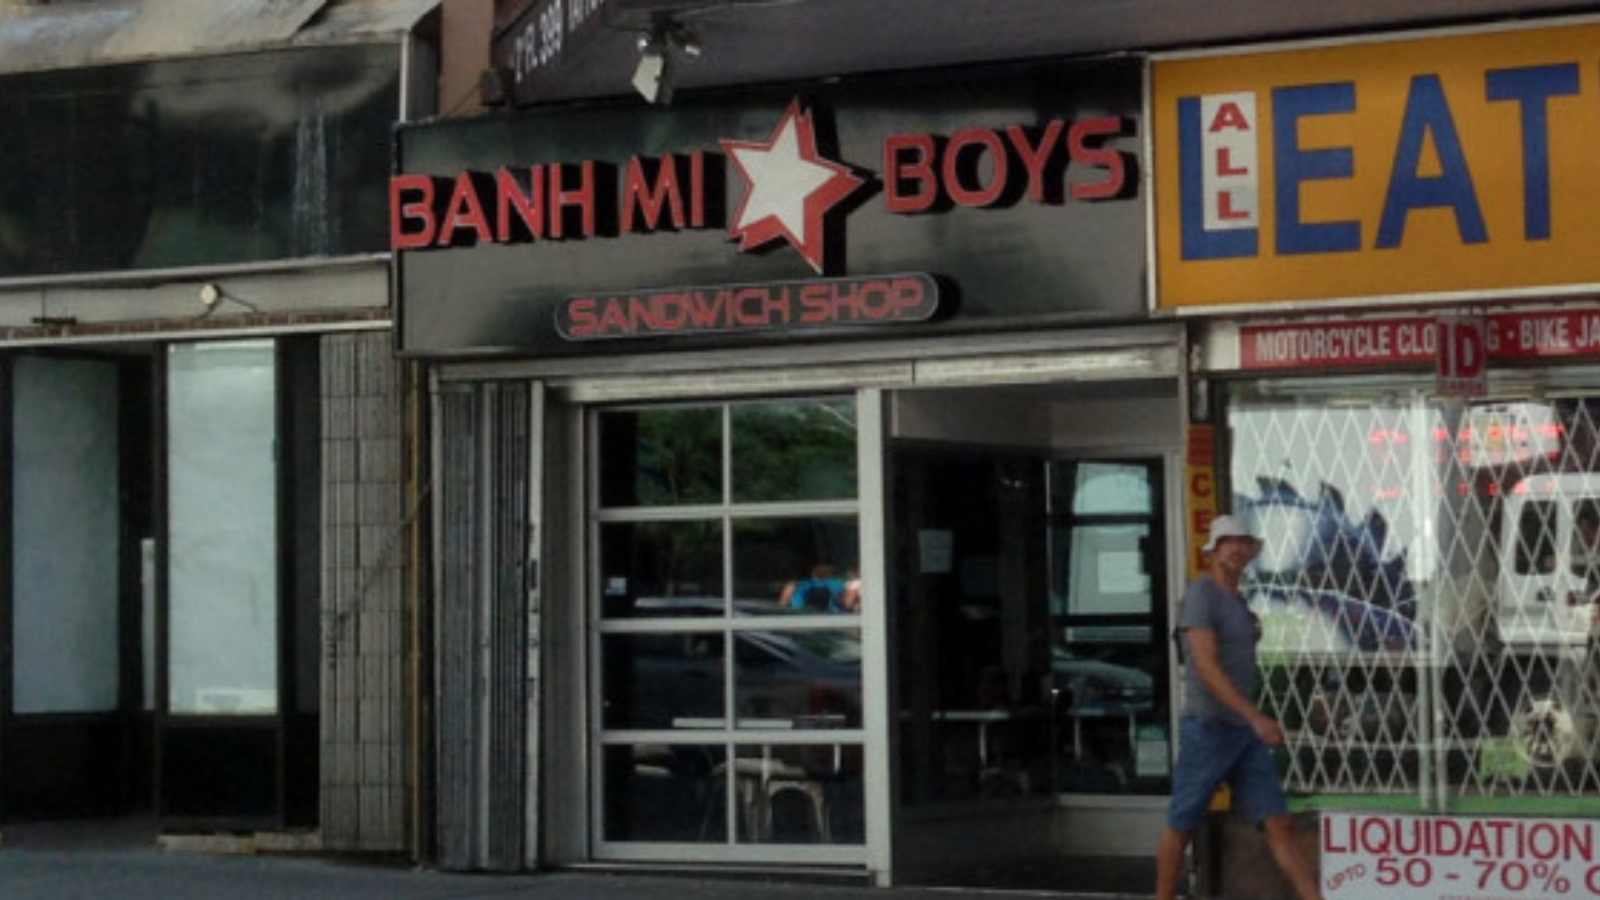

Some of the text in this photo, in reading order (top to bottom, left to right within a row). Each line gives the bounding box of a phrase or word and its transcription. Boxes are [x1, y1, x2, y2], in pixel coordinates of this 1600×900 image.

[389, 115, 1127, 250] BANH MI BOYS
[1178, 62, 1600, 261] LEAT
[1208, 101, 1250, 221] ALL
[568, 277, 925, 337] SANDWICH SHOP
[1255, 325, 1391, 362] MOTORCYCLE
[1520, 317, 1569, 350] BIKE
[1323, 816, 1593, 861] LIQUIDATION
[1375, 858, 1433, 888] 50
[1473, 860, 1571, 895] 70%
